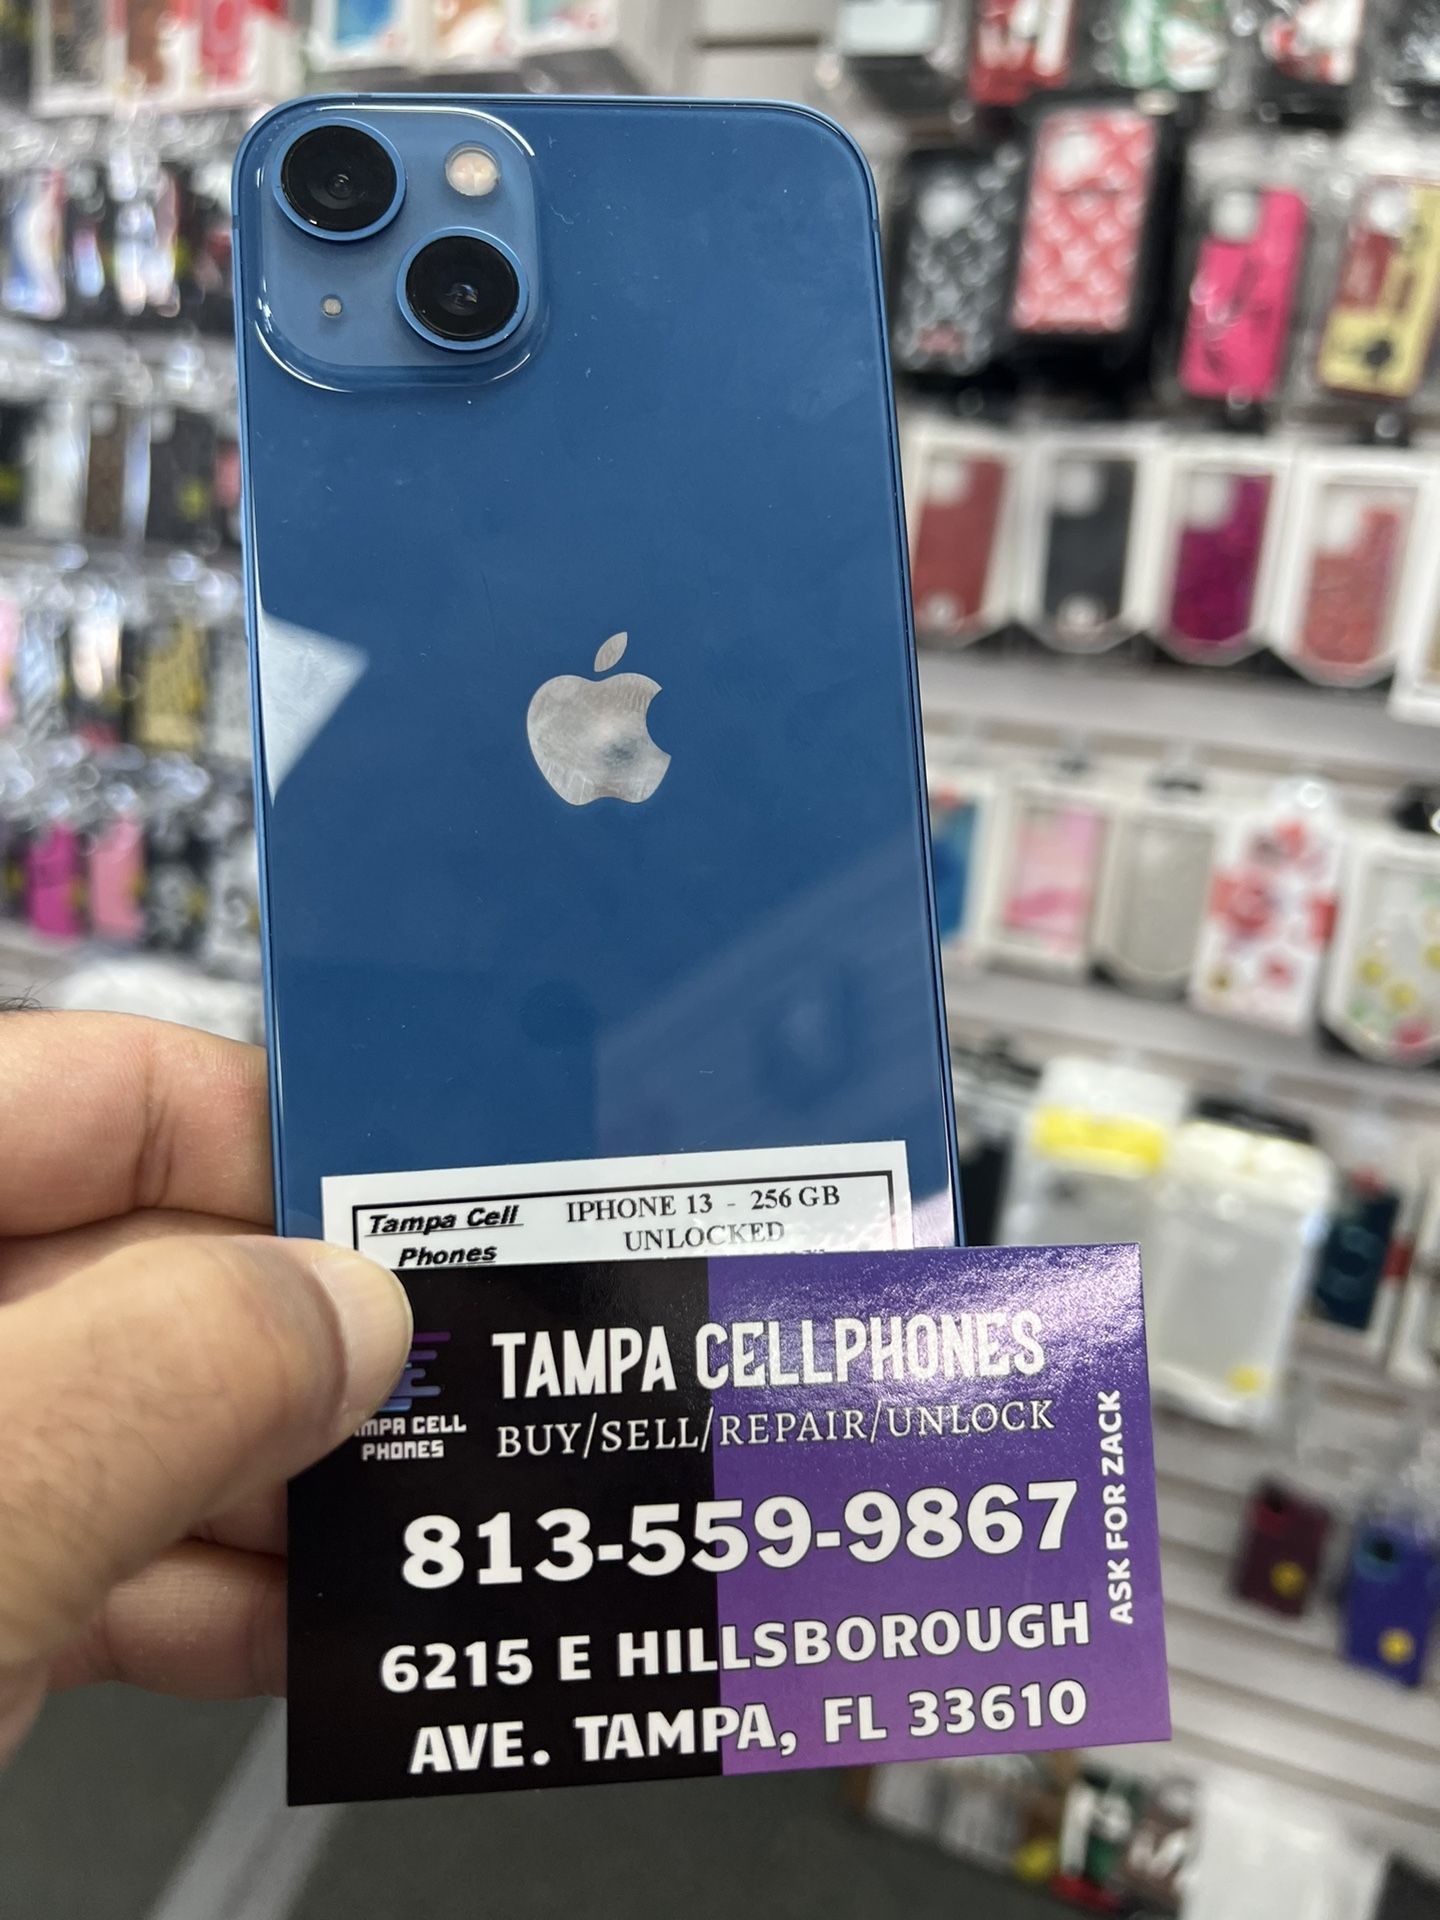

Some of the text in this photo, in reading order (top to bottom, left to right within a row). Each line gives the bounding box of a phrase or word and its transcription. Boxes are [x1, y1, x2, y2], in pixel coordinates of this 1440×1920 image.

[369, 1204, 520, 1236] Tampa Cell
[566, 1195, 676, 1223] IPHONE
[687, 1193, 713, 1214] 13
[751, 1188, 792, 1211] 256
[798, 1184, 840, 1207] GB
[398, 1246, 498, 1268] Phones
[624, 1221, 785, 1251] UNLOCKED
[491, 1310, 1046, 1400] TAMPA CELLPHONES
[412, 1414, 468, 1435] CELL
[497, 1399, 1055, 1459] BUY/SELL/REPAIR/UNLOCK
[361, 1439, 445, 1461] PHONES
[1097, 1389, 1134, 1625] ASK FOR ZACK
[401, 1480, 1080, 1590] 813-559-9867
[381, 1601, 1090, 1693] 6215 E HILLSBOROUGH
[408, 1679, 1087, 1775] AVE. TAMPA, FL 33610
